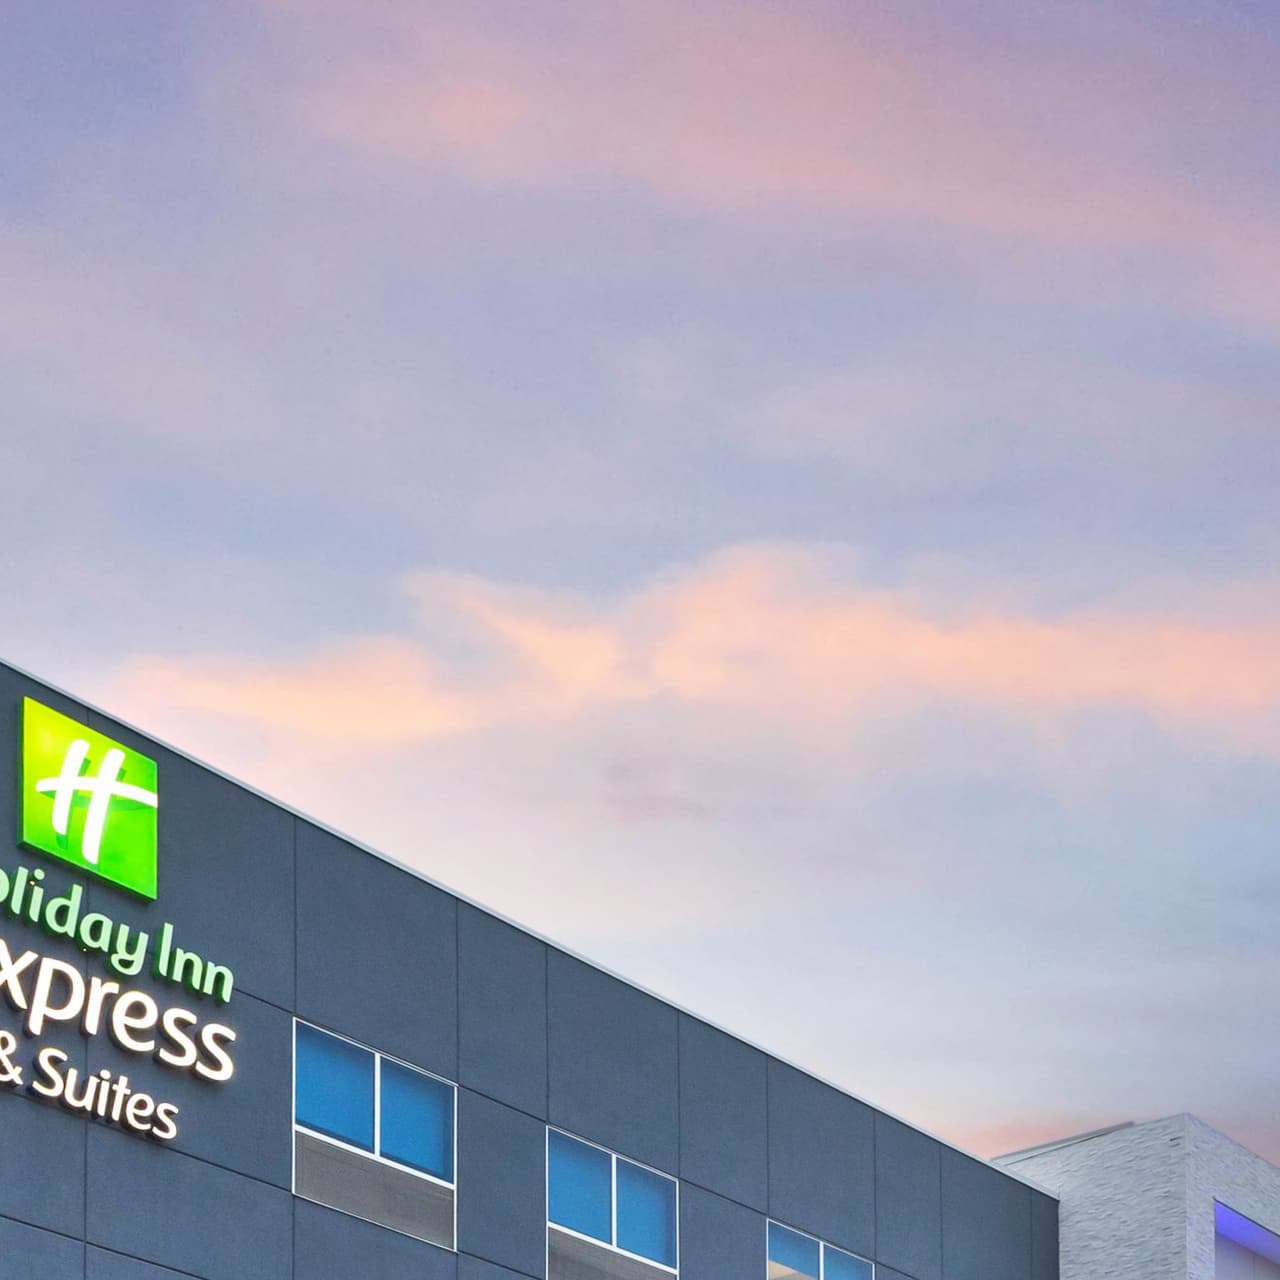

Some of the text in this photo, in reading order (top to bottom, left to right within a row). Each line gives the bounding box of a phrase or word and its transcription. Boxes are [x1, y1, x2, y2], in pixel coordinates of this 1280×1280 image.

[35, 739, 158, 865] H
[157, 922, 234, 1003] Inn
[32, 1047, 179, 1140] Suites
